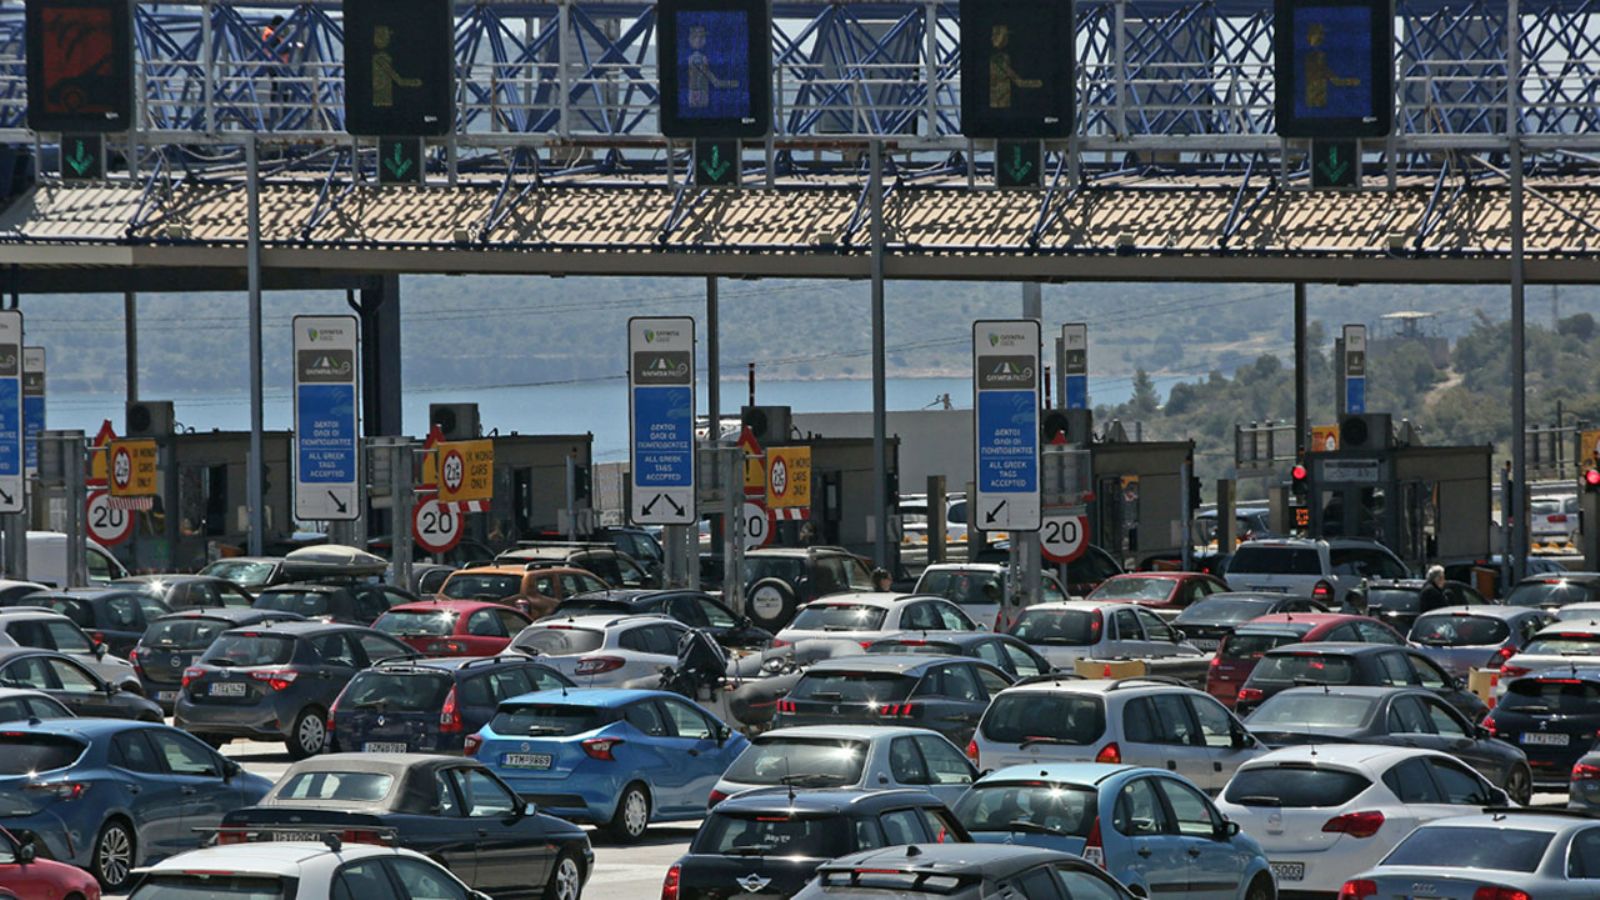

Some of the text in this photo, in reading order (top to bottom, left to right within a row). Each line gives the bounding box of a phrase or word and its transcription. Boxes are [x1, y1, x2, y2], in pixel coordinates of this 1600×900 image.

[471, 463, 488, 475] CARS
[471, 478, 487, 489] ONLY
[94, 506, 123, 527] 20
[423, 512, 452, 533] 20
[743, 515, 762, 537] 0
[1045, 521, 1076, 544] 20
